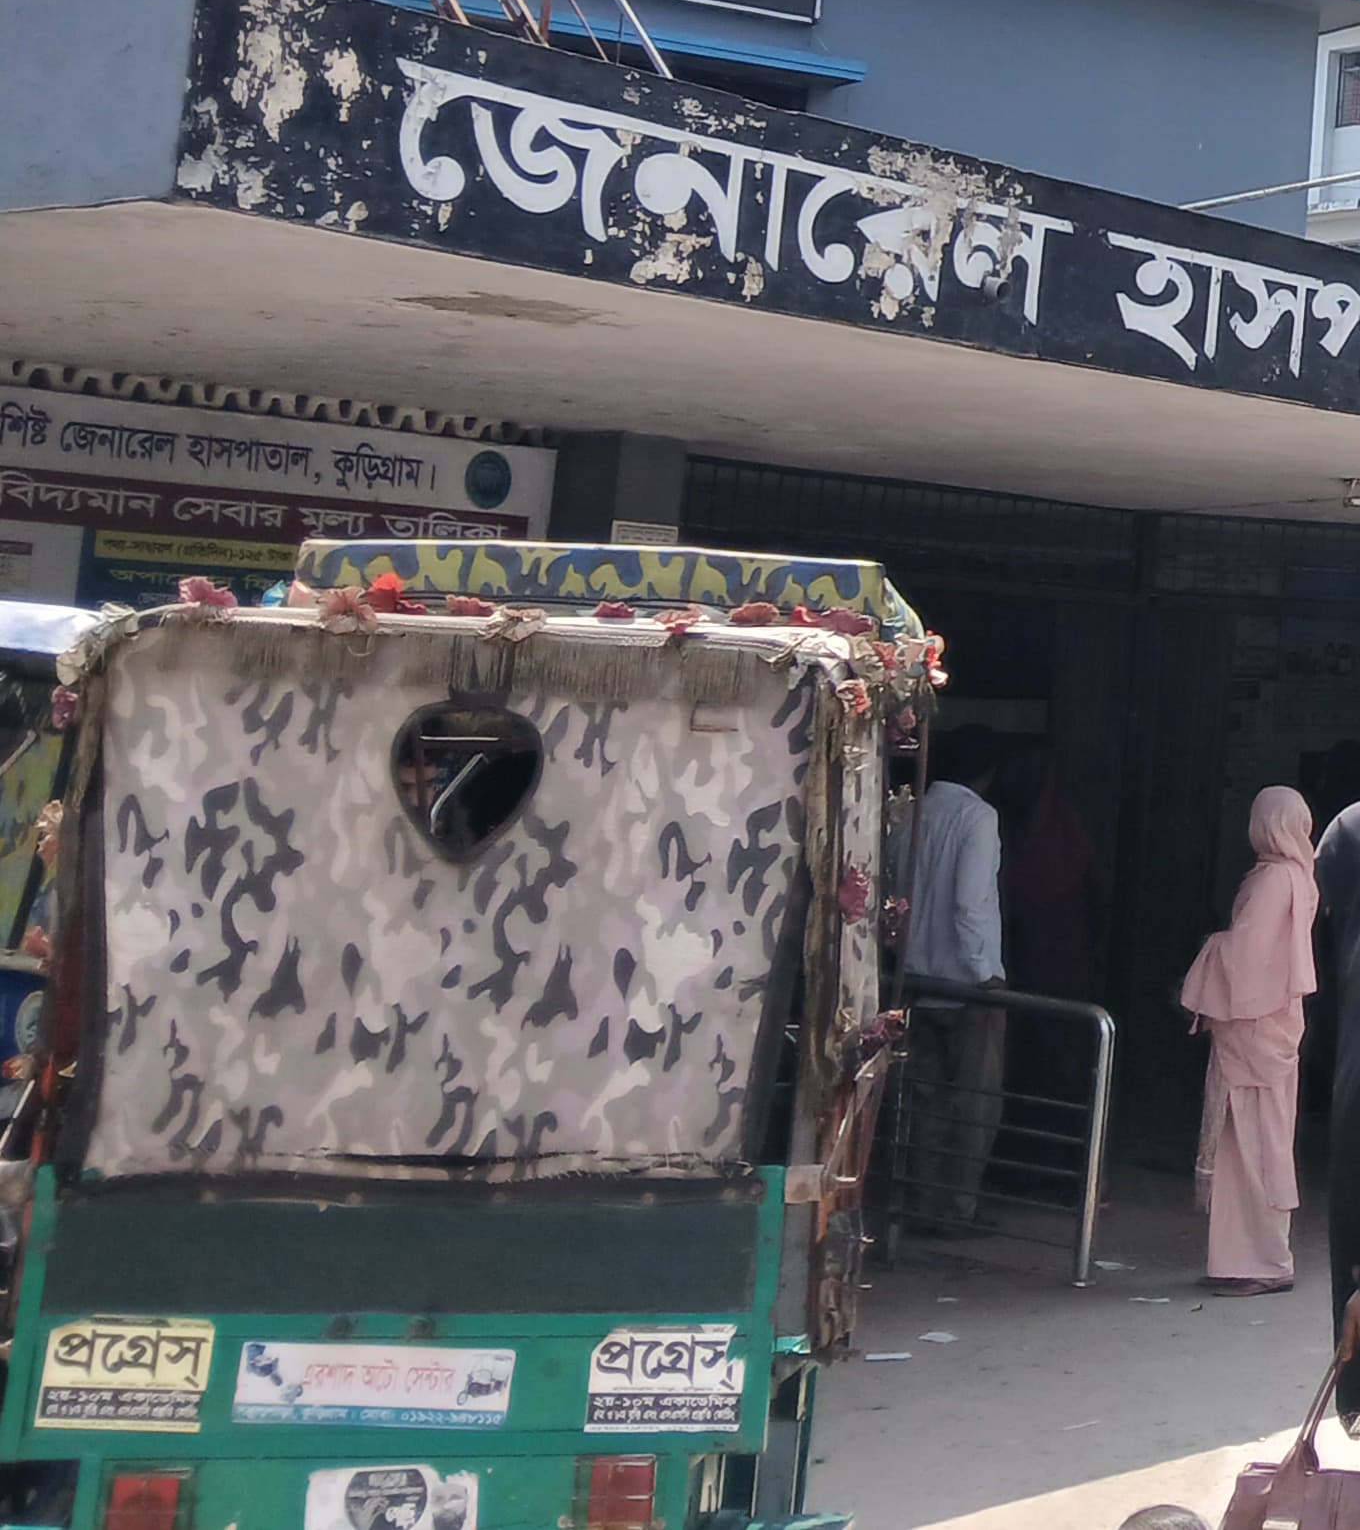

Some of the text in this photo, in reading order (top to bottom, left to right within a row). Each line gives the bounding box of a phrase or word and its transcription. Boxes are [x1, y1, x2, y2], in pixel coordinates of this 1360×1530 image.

[396, 57, 1073, 326] জেনারেল
[0, 401, 53, 448] শিষ্ট
[60, 421, 180, 465] জেনারেল
[186, 433, 321, 484] হাসপাতাল,
[0, 470, 509, 539] বিদ্যমান সেবার মূল্য তালিকা
